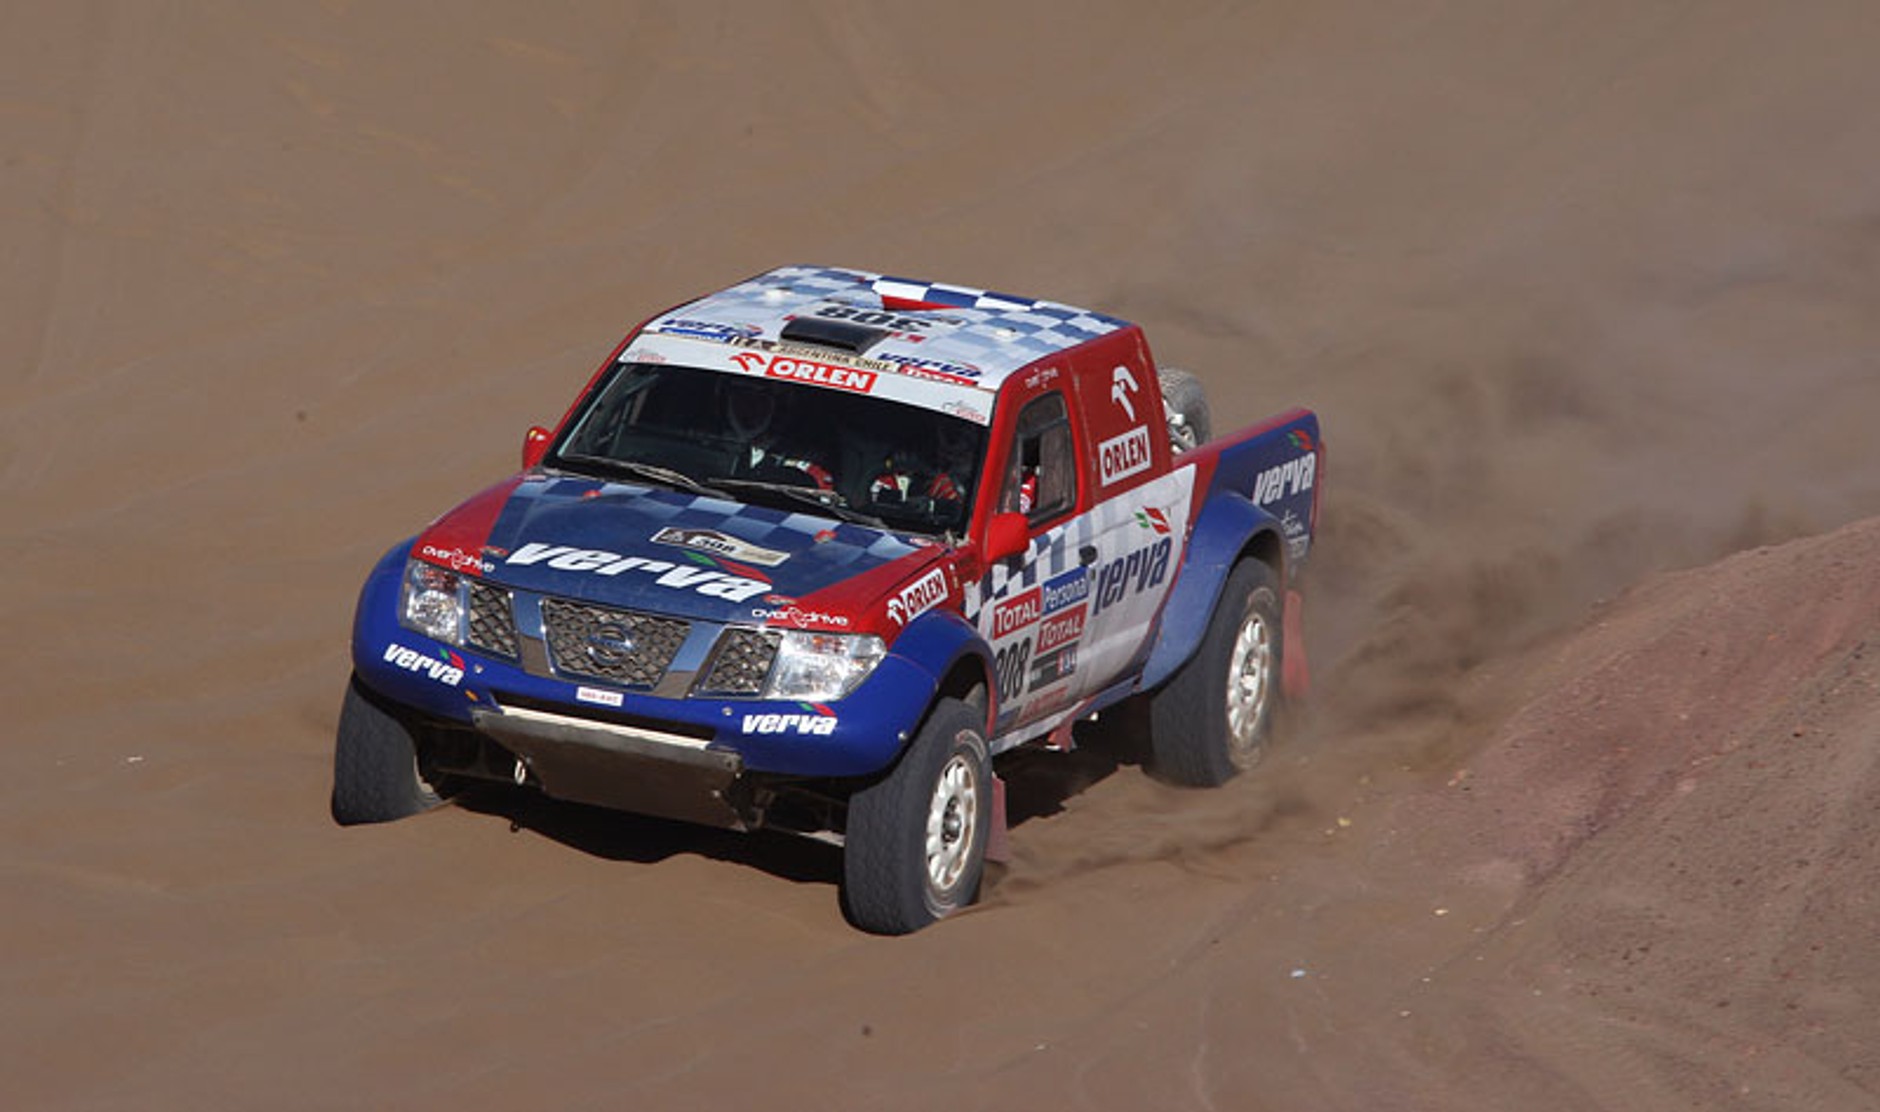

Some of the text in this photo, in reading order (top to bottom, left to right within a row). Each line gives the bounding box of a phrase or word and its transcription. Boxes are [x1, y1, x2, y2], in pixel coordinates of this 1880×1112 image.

[772, 361, 870, 390] ORLEN
[877, 353, 982, 377] verva
[1103, 432, 1148, 478] ORLEN
[1252, 451, 1317, 507] verva
[506, 543, 773, 603] verva
[1092, 535, 1172, 617] verva
[906, 573, 945, 614] ORLEN
[1045, 577, 1087, 609] Personal
[996, 598, 1040, 634] TOTAL
[1040, 615, 1081, 649] TOTAL
[383, 643, 465, 687] verva
[742, 714, 839, 735] verva
